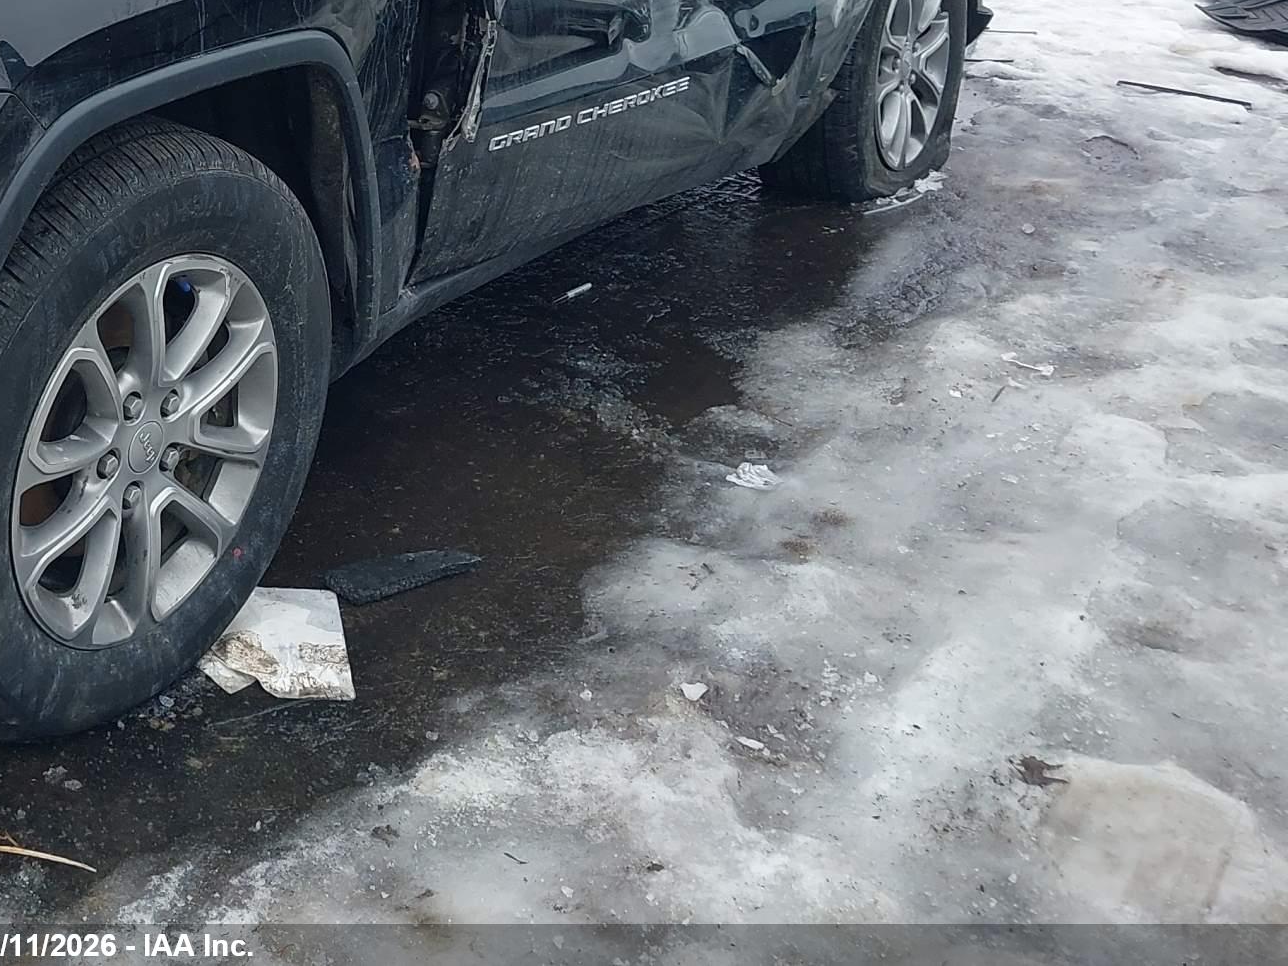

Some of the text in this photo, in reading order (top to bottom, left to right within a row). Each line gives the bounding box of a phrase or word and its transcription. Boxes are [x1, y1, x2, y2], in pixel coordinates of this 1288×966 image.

[488, 76, 691, 152] GRAND CHEROKEE
[138, 433, 157, 464] Jeep
